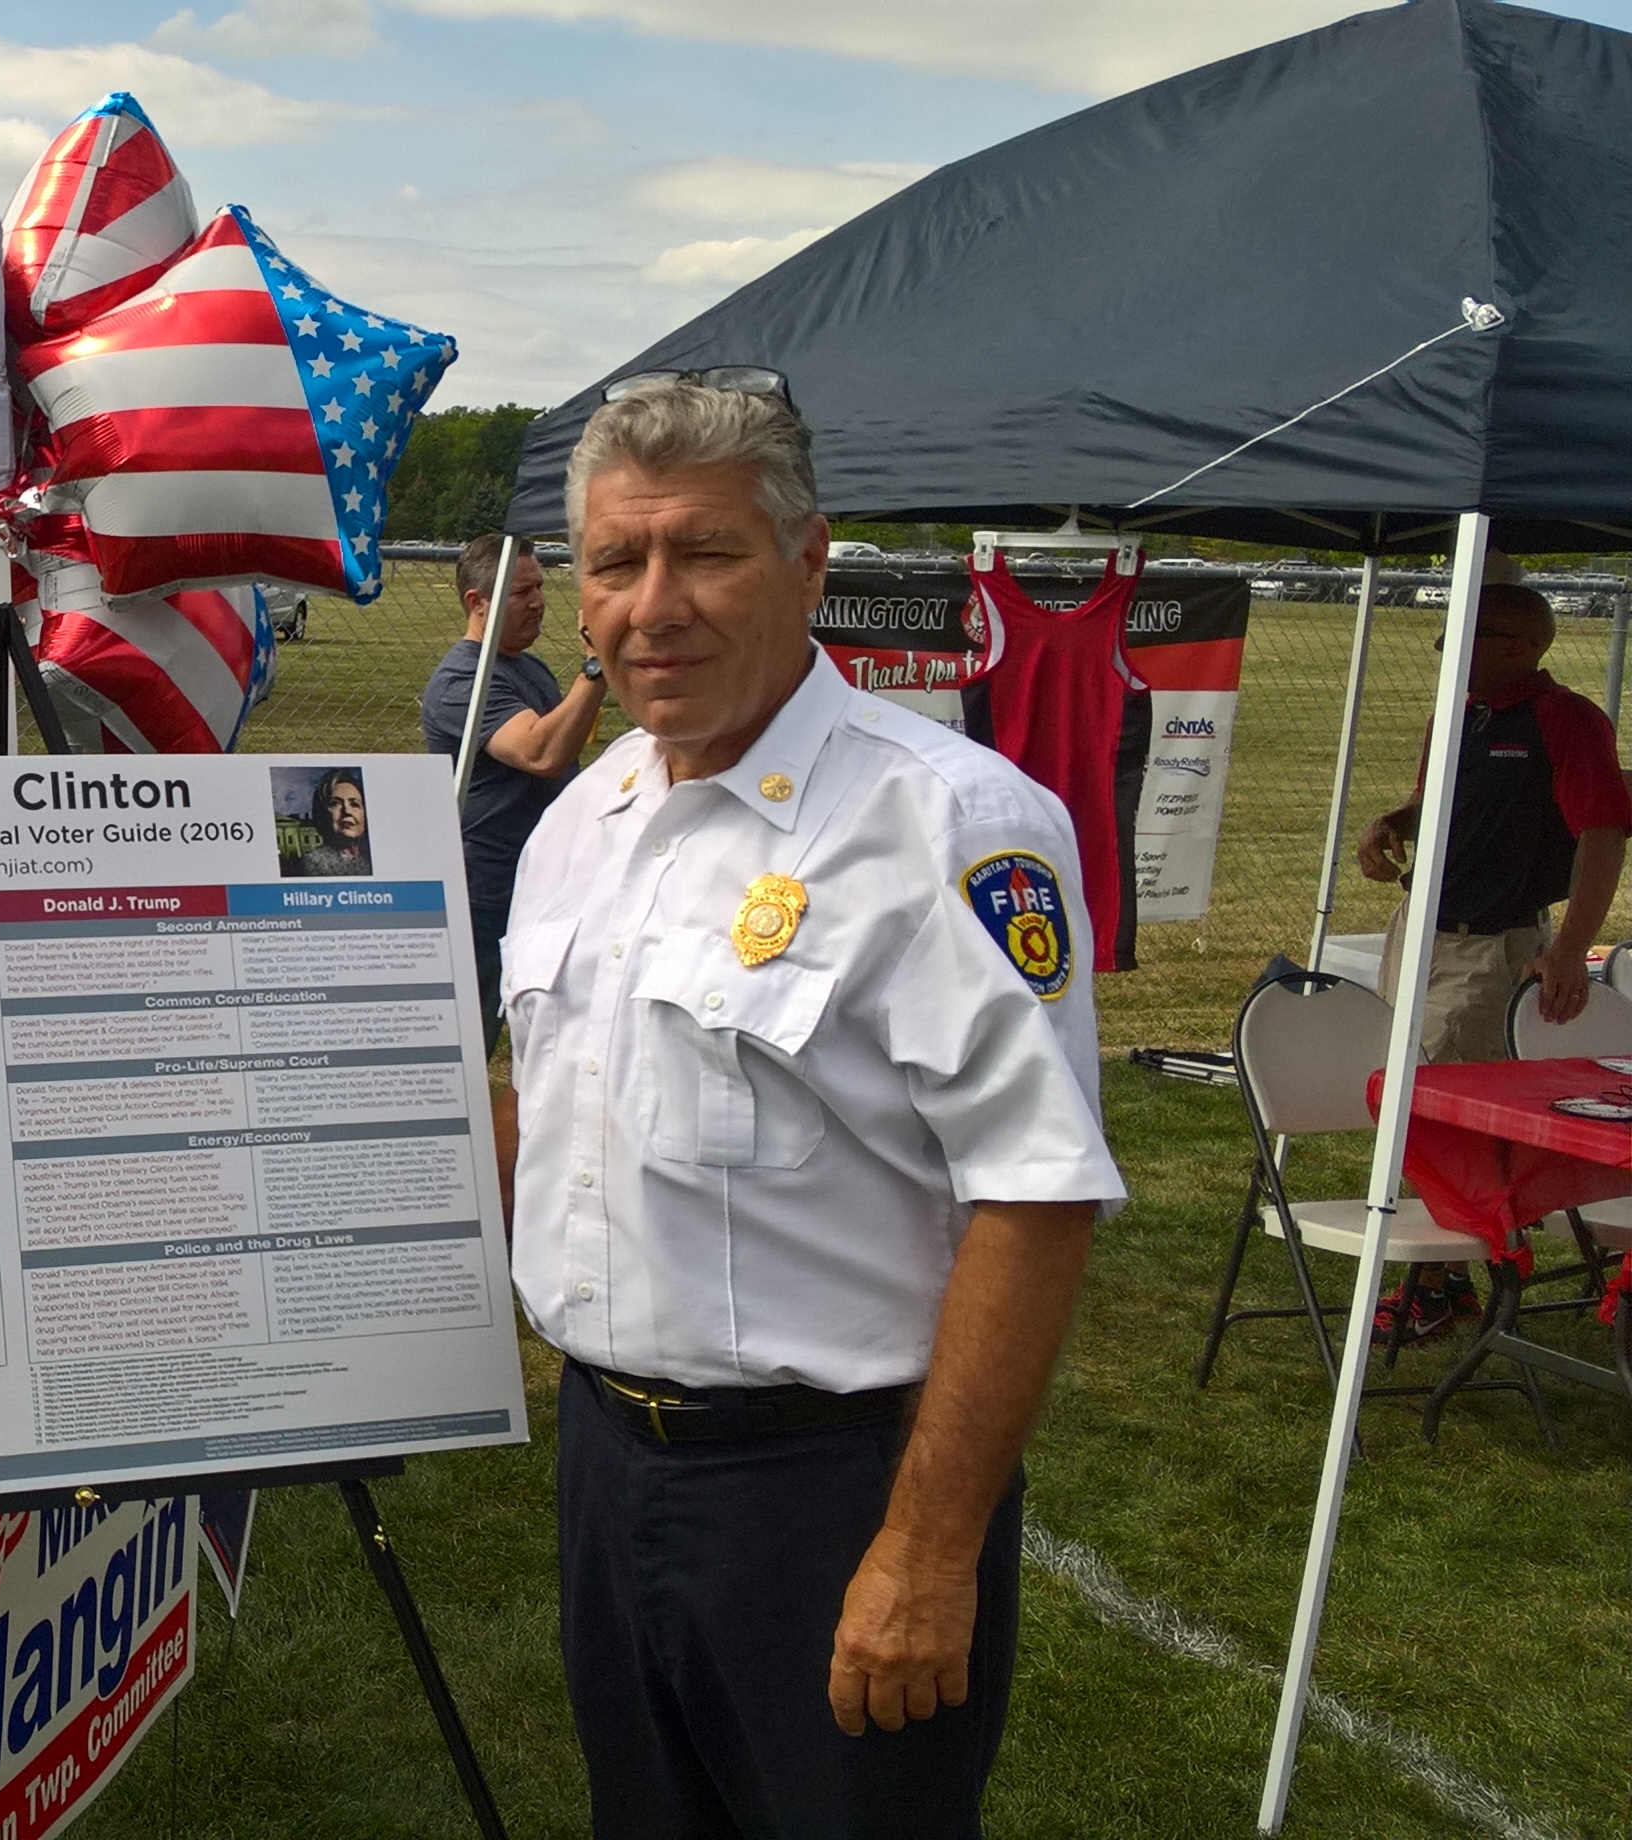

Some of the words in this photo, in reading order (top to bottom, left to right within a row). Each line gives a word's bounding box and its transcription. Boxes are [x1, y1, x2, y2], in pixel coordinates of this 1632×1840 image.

[812, 596, 948, 631] MINGTON
[849, 650, 918, 692] Thank
[924, 658, 959, 694] you
[12, 769, 190, 811] Clinton
[28, 824, 95, 844] Voter
[102, 822, 171, 843] Guide
[179, 821, 254, 844] (2016)
[969, 858, 1011, 888] RARITAN
[43, 896, 103, 912] Donald
[107, 897, 122, 910] J.
[126, 895, 180, 912] Trump
[283, 891, 334, 908] Hillary
[337, 889, 392, 905] Clinton
[989, 887, 1056, 916] FIRE
[155, 920, 213, 933] Second
[215, 917, 302, 931] Amendment
[144, 994, 210, 1007] Common
[214, 989, 326, 1005] Core/Education
[155, 1056, 285, 1075] Pro-Life/Supreme
[288, 1054, 329, 1067] Court
[188, 1129, 311, 1149] Energy/Economy
[164, 1241, 211, 1256] Police
[215, 1240, 243, 1252] and
[247, 1238, 271, 1250] the
[275, 1235, 311, 1250] Drug
[315, 1232, 353, 1245] Laws
[37, 1502, 120, 1578] Mik
[24, 1753, 81, 1827] Twp.
[87, 1626, 185, 1763] Committee
